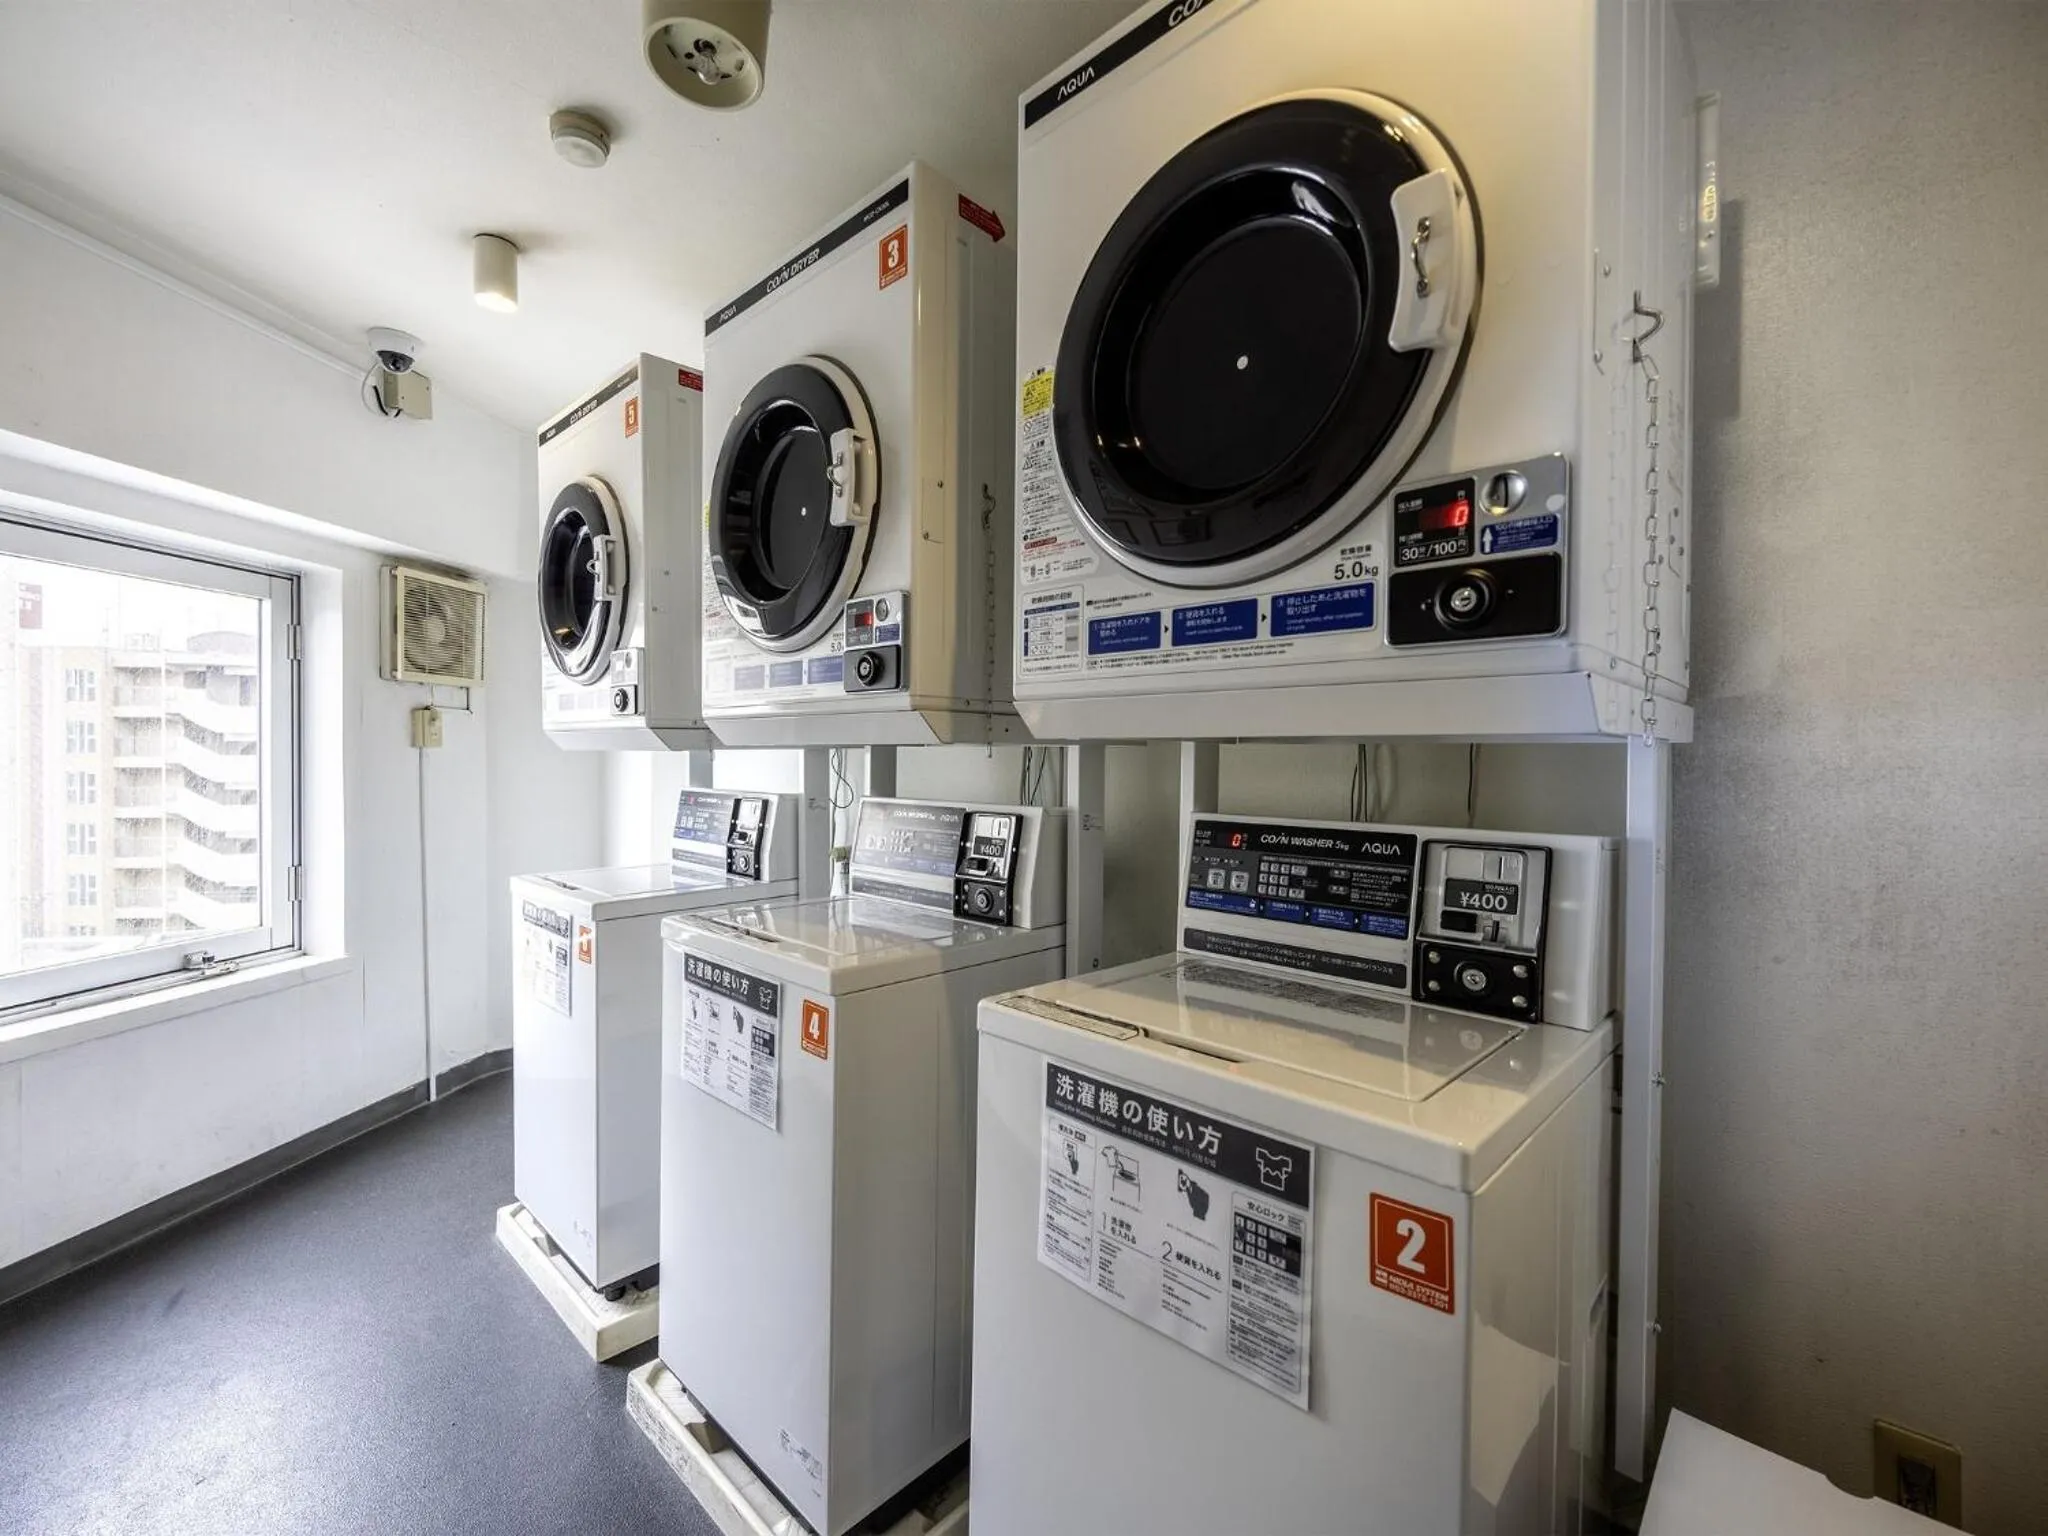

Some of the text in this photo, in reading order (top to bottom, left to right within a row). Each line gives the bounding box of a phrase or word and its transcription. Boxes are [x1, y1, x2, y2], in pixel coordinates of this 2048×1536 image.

[1057, 0, 1203, 101] AQUA CO
[888, 240, 899, 268] 3
[629, 405, 635, 424] 5
[1454, 506, 1469, 527] 0
[1260, 833, 1288, 845] COIN
[1291, 836, 1333, 849] WASHER
[1361, 842, 1401, 856] AQUA
[1460, 891, 1508, 911] ¥400
[687, 957, 750, 995] 洗濯機の使い方
[809, 1011, 820, 1040] 4
[1056, 1073, 1222, 1155] 洗濯機の使い方
[1162, 1241, 1172, 1262] 2
[1396, 1218, 1426, 1274] 2
